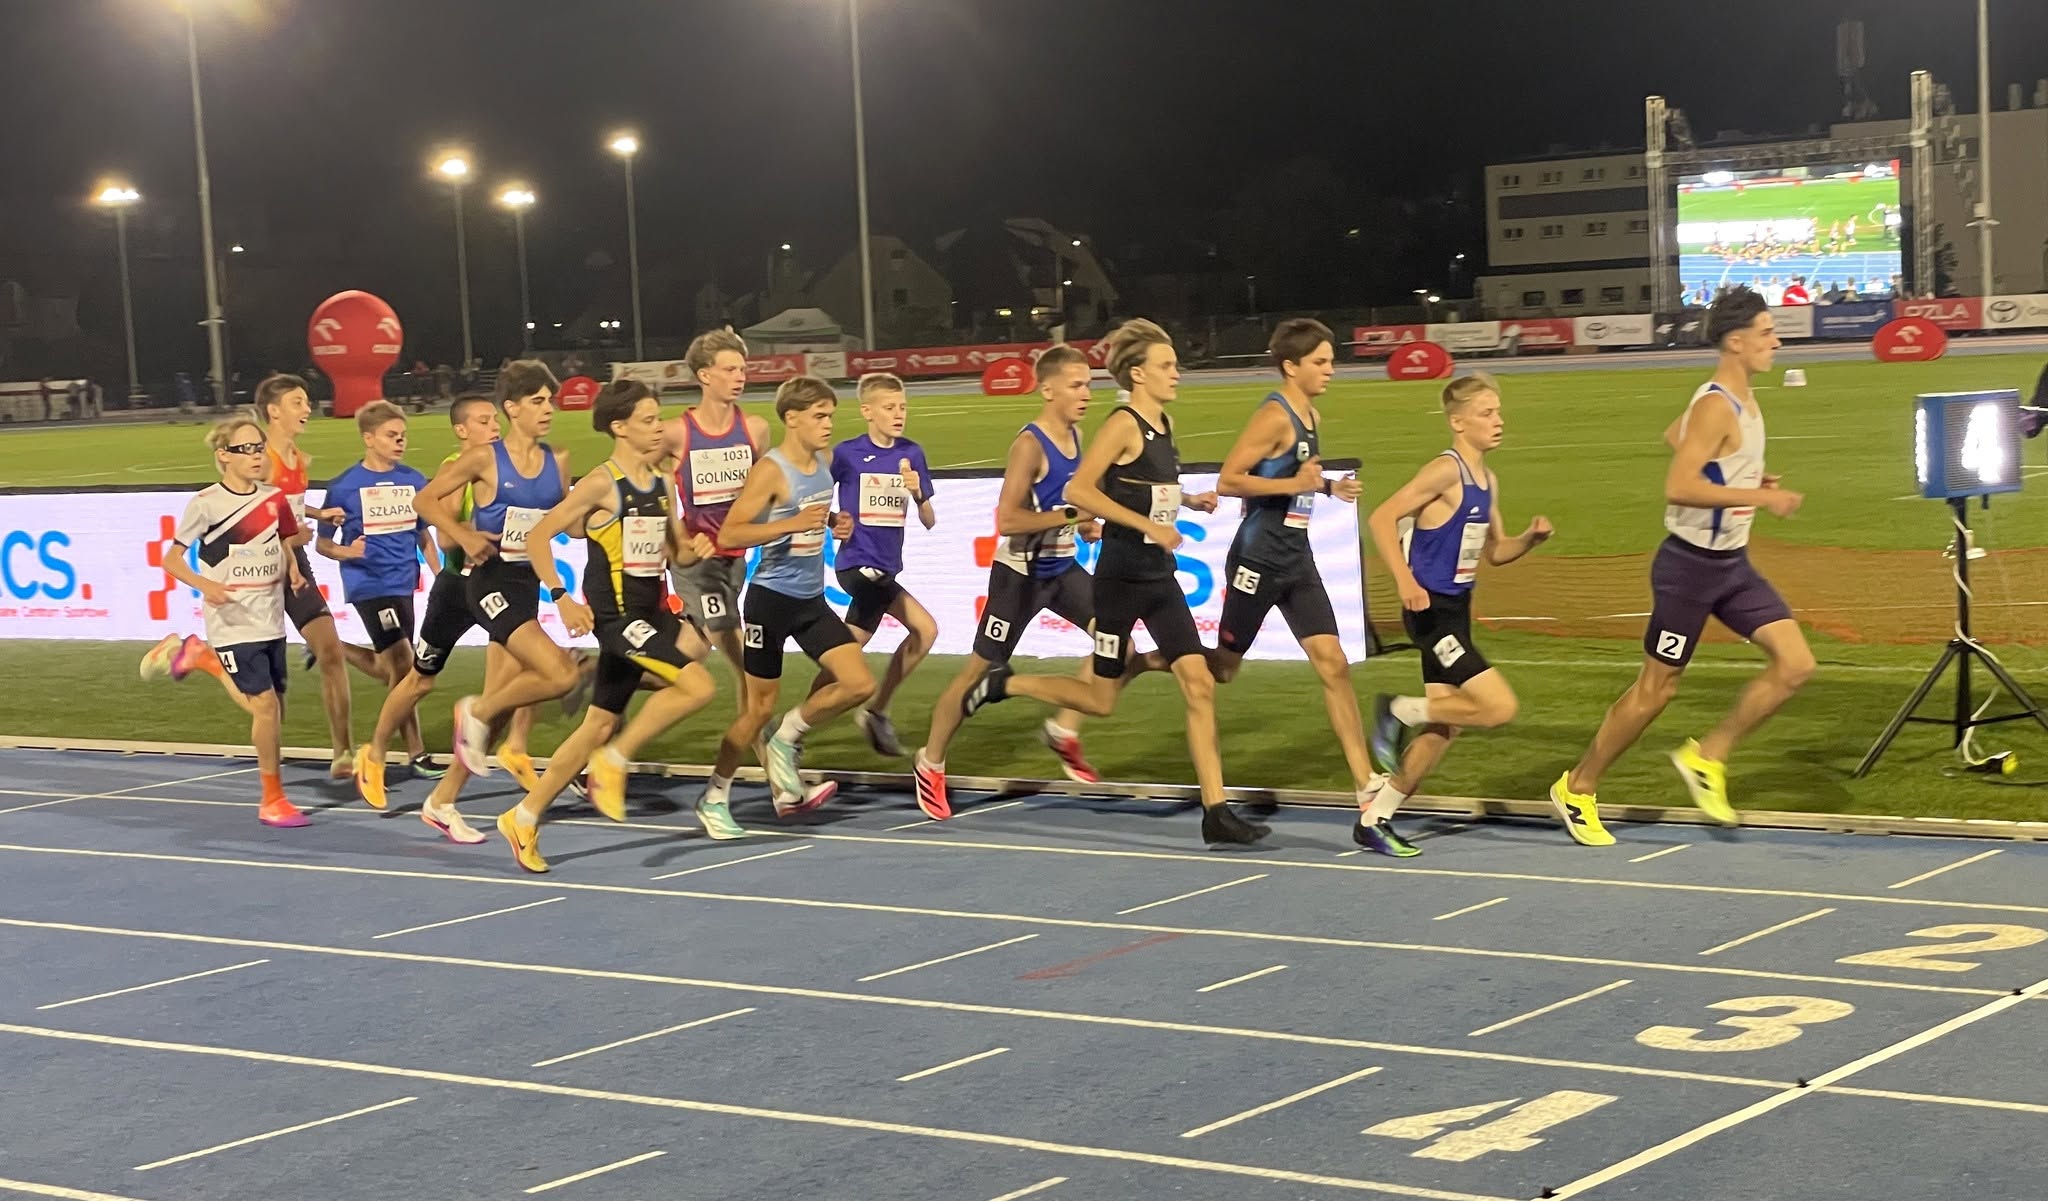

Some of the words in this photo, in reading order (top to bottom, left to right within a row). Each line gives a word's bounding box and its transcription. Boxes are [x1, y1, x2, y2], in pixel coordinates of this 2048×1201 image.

[723, 449, 750, 462] 1031
[392, 488, 411, 497] 972
[890, 478, 907, 488] 12
[369, 504, 412, 517] SZŁAPA
[1238, 571, 1257, 591] 15
[484, 594, 505, 615] 10
[707, 595, 720, 615] 8
[745, 627, 762, 645] 12
[990, 620, 1002, 639] 6
[1098, 635, 1116, 655] 11
[1662, 635, 1680, 656] 2
[1835, 923, 2048, 973] 2
[1634, 995, 1855, 1052] 3
[1361, 1089, 1620, 1162] 4
